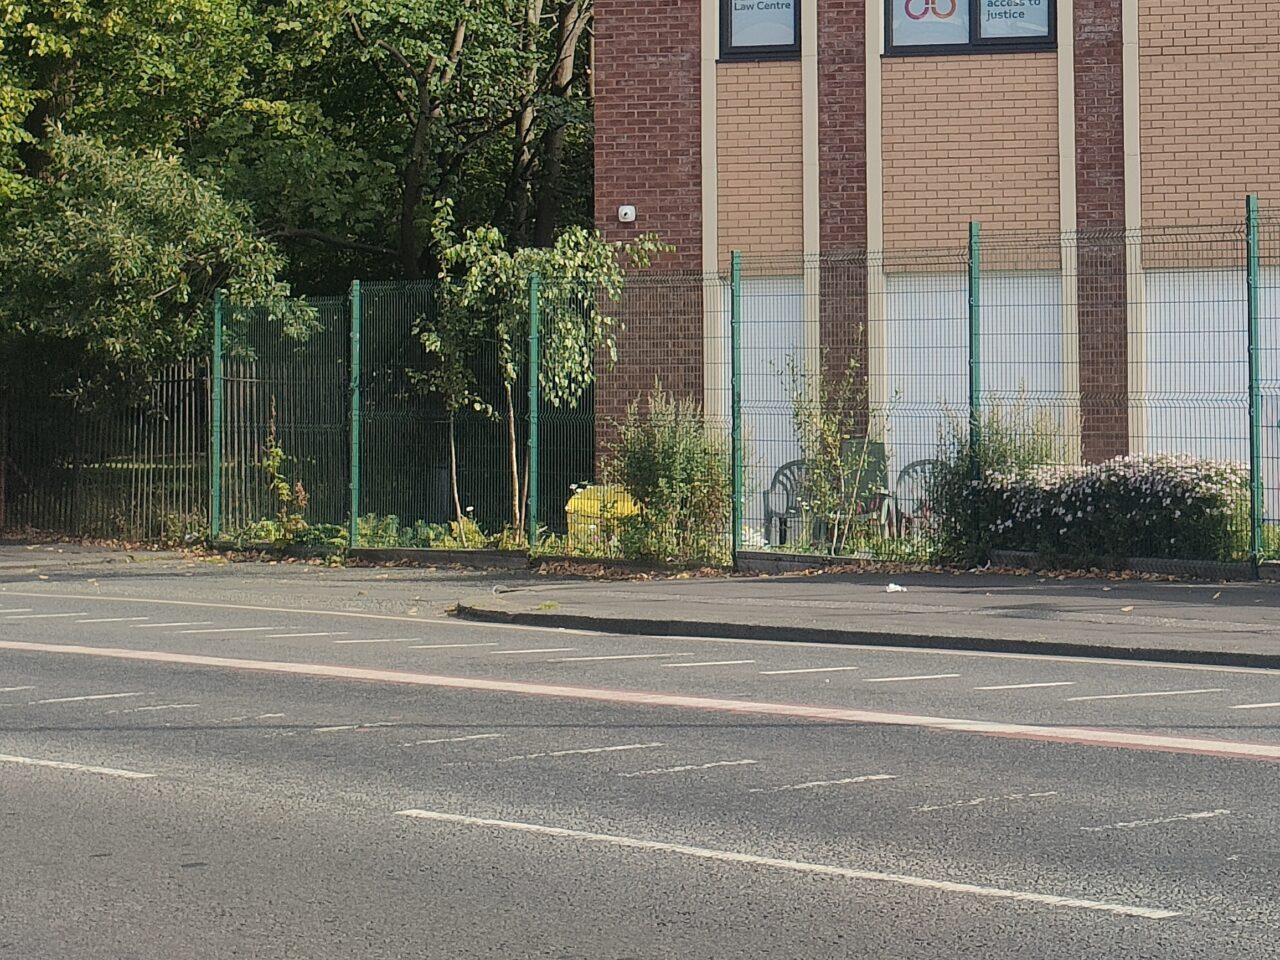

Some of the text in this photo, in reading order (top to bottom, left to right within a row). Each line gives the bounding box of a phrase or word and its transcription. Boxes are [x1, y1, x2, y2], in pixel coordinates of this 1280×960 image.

[734, 1, 791, 11] Law Centre
[986, 9, 1025, 22] justice
